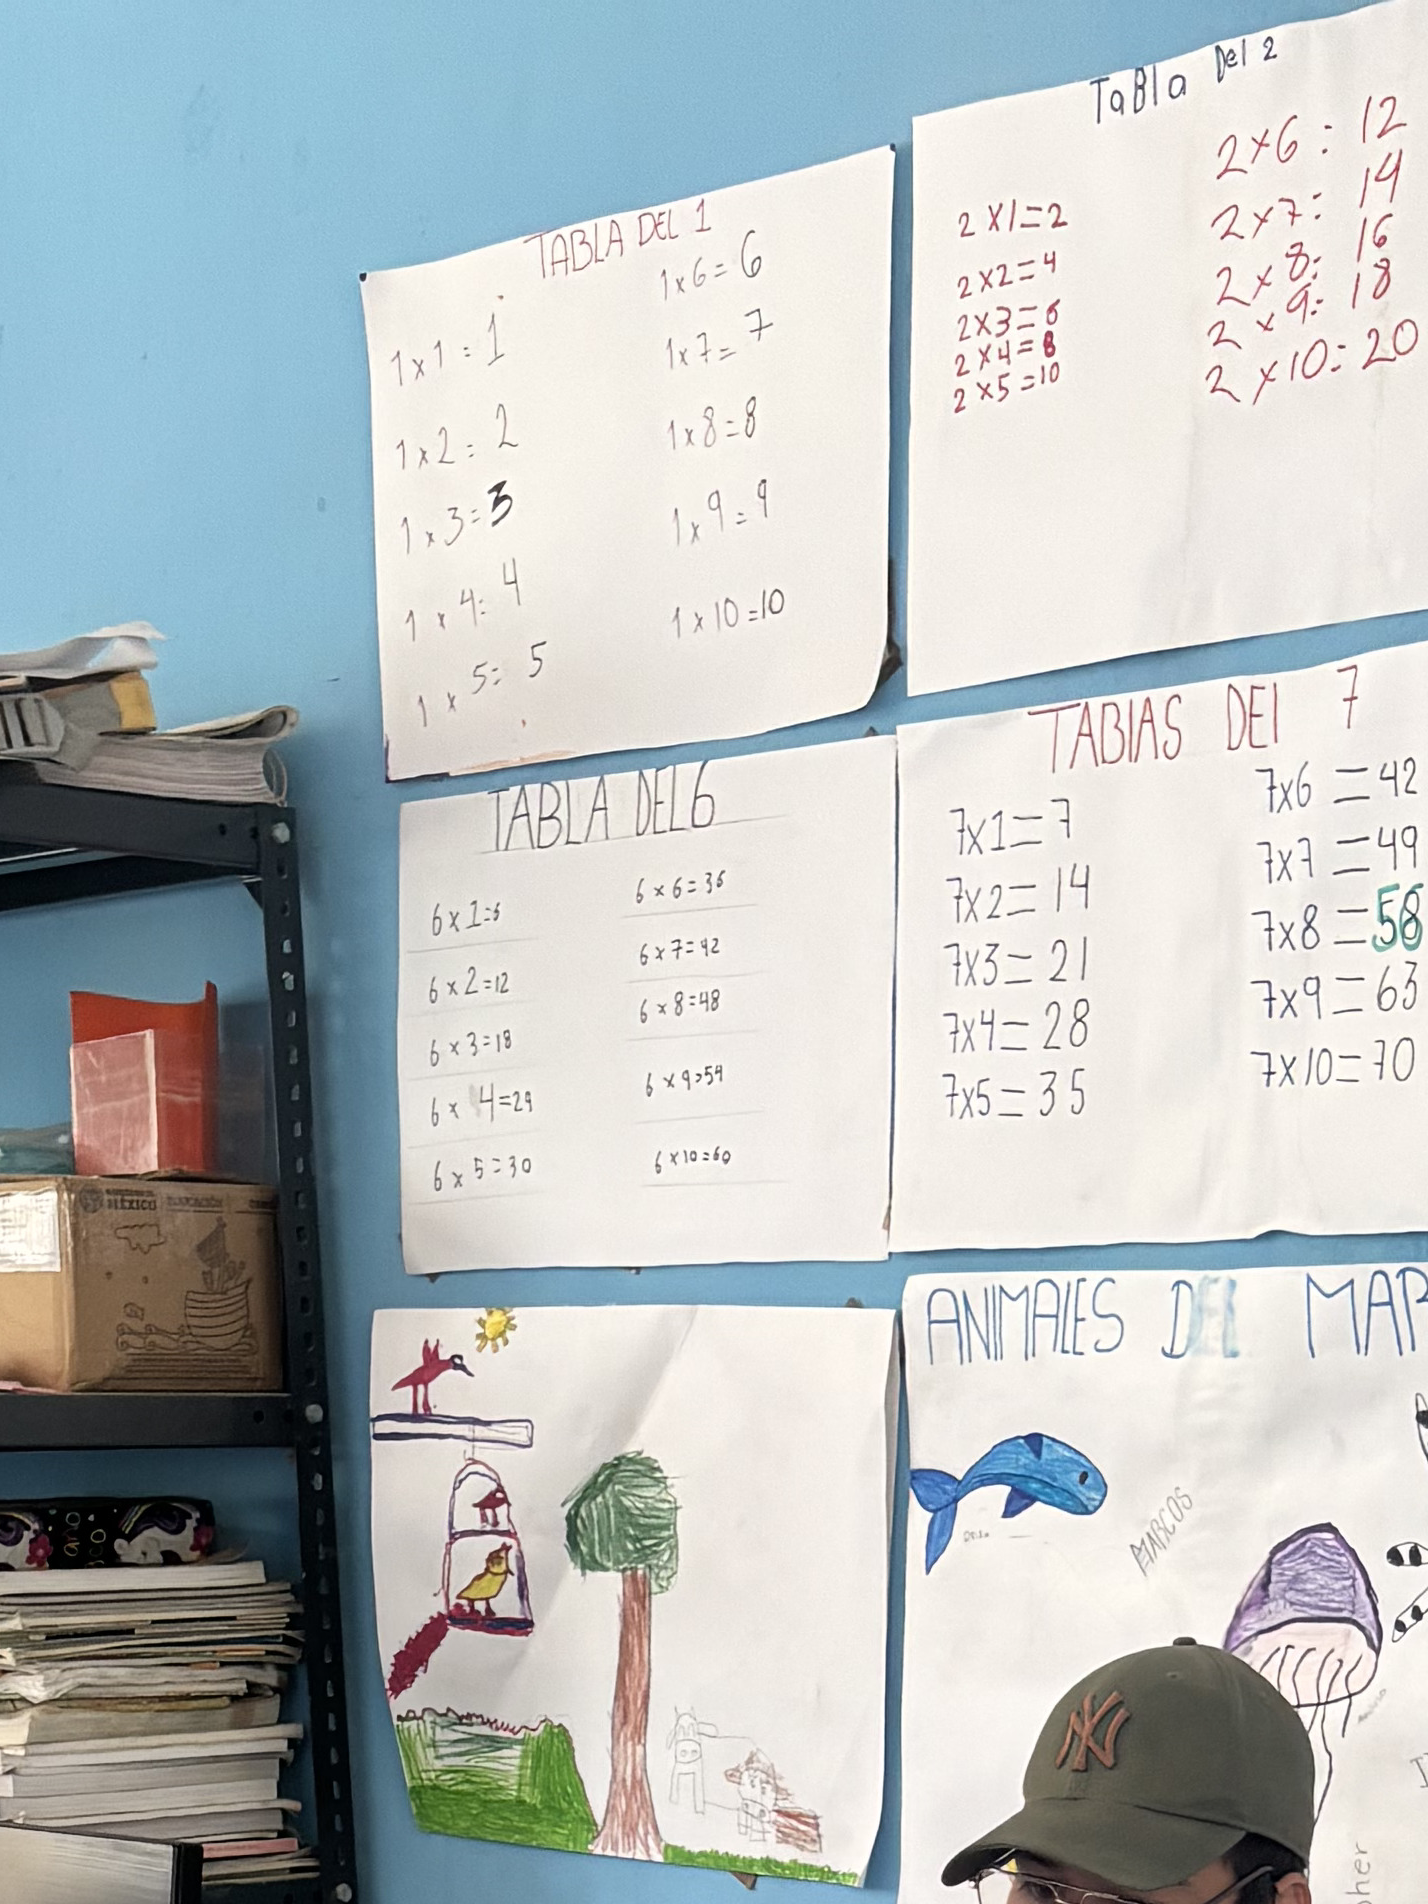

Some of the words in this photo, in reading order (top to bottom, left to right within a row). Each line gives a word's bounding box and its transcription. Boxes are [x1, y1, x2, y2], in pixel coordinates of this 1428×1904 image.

[1215, 37, 1246, 84] Del
[1263, 36, 1278, 62] 2
[524, 220, 624, 279] TABLA
[638, 208, 679, 248] DEL
[695, 198, 712, 234] 1
[1337, 665, 1359, 729] 7
[488, 774, 610, 852] TABLA
[635, 764, 687, 837] DEL
[691, 760, 715, 828] 6
[927, 1277, 1125, 1365] ANIMALES
[1160, 1276, 1239, 1360] DEL
[1129, 1486, 1192, 1577] MARCOS
[1055, 1690, 1130, 1772] NY
